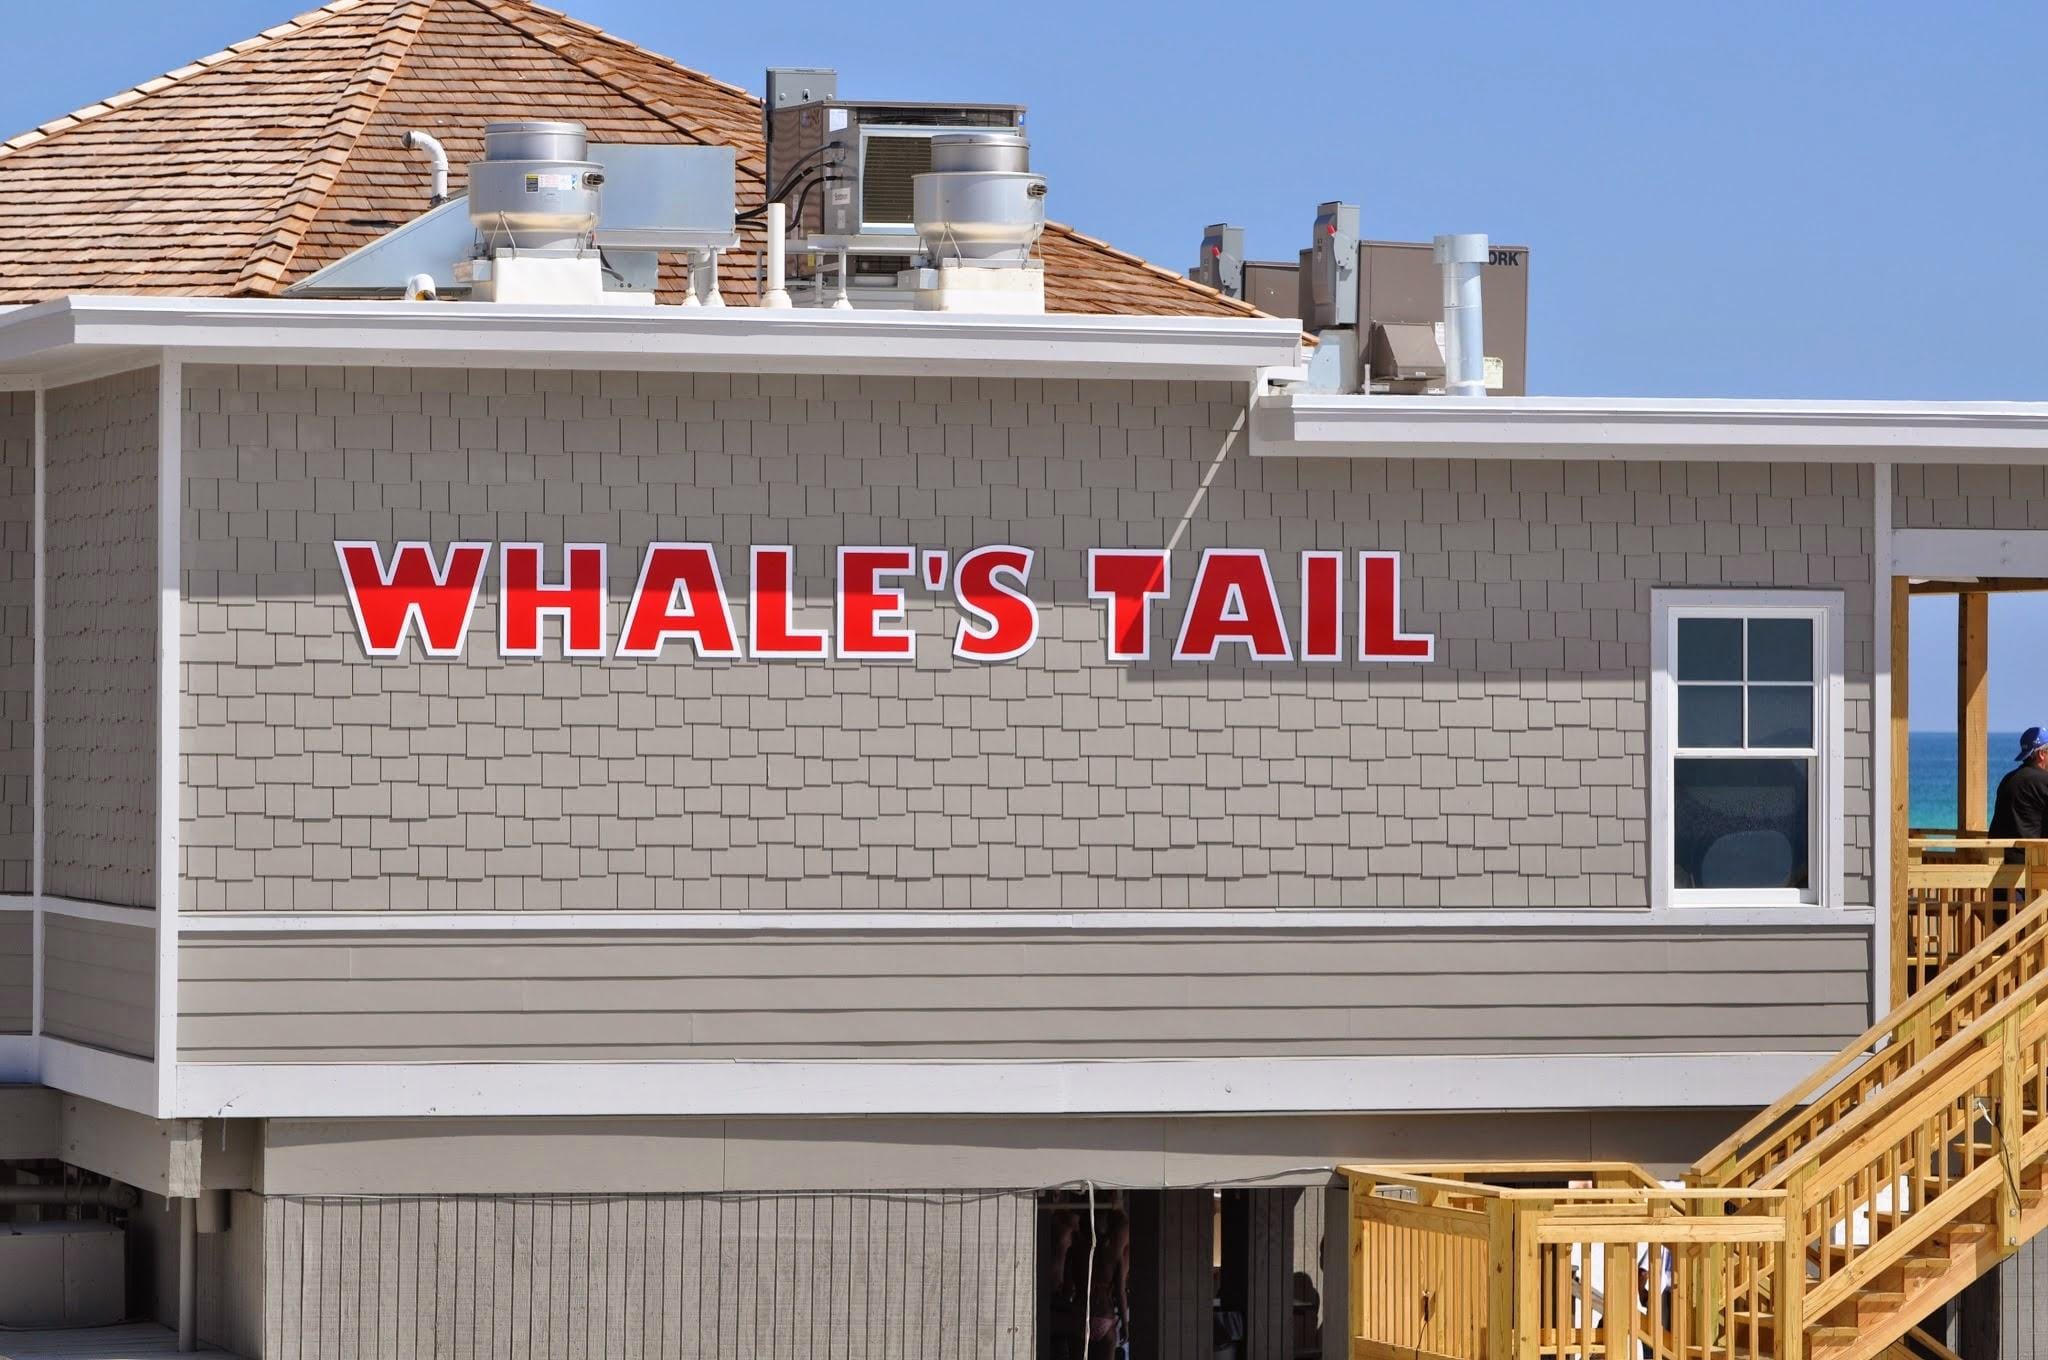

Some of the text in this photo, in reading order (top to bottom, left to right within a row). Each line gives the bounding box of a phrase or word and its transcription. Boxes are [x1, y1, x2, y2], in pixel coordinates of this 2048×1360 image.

[1488, 251, 1519, 266] ORK
[334, 541, 1435, 662] WHALE'S TAIL
